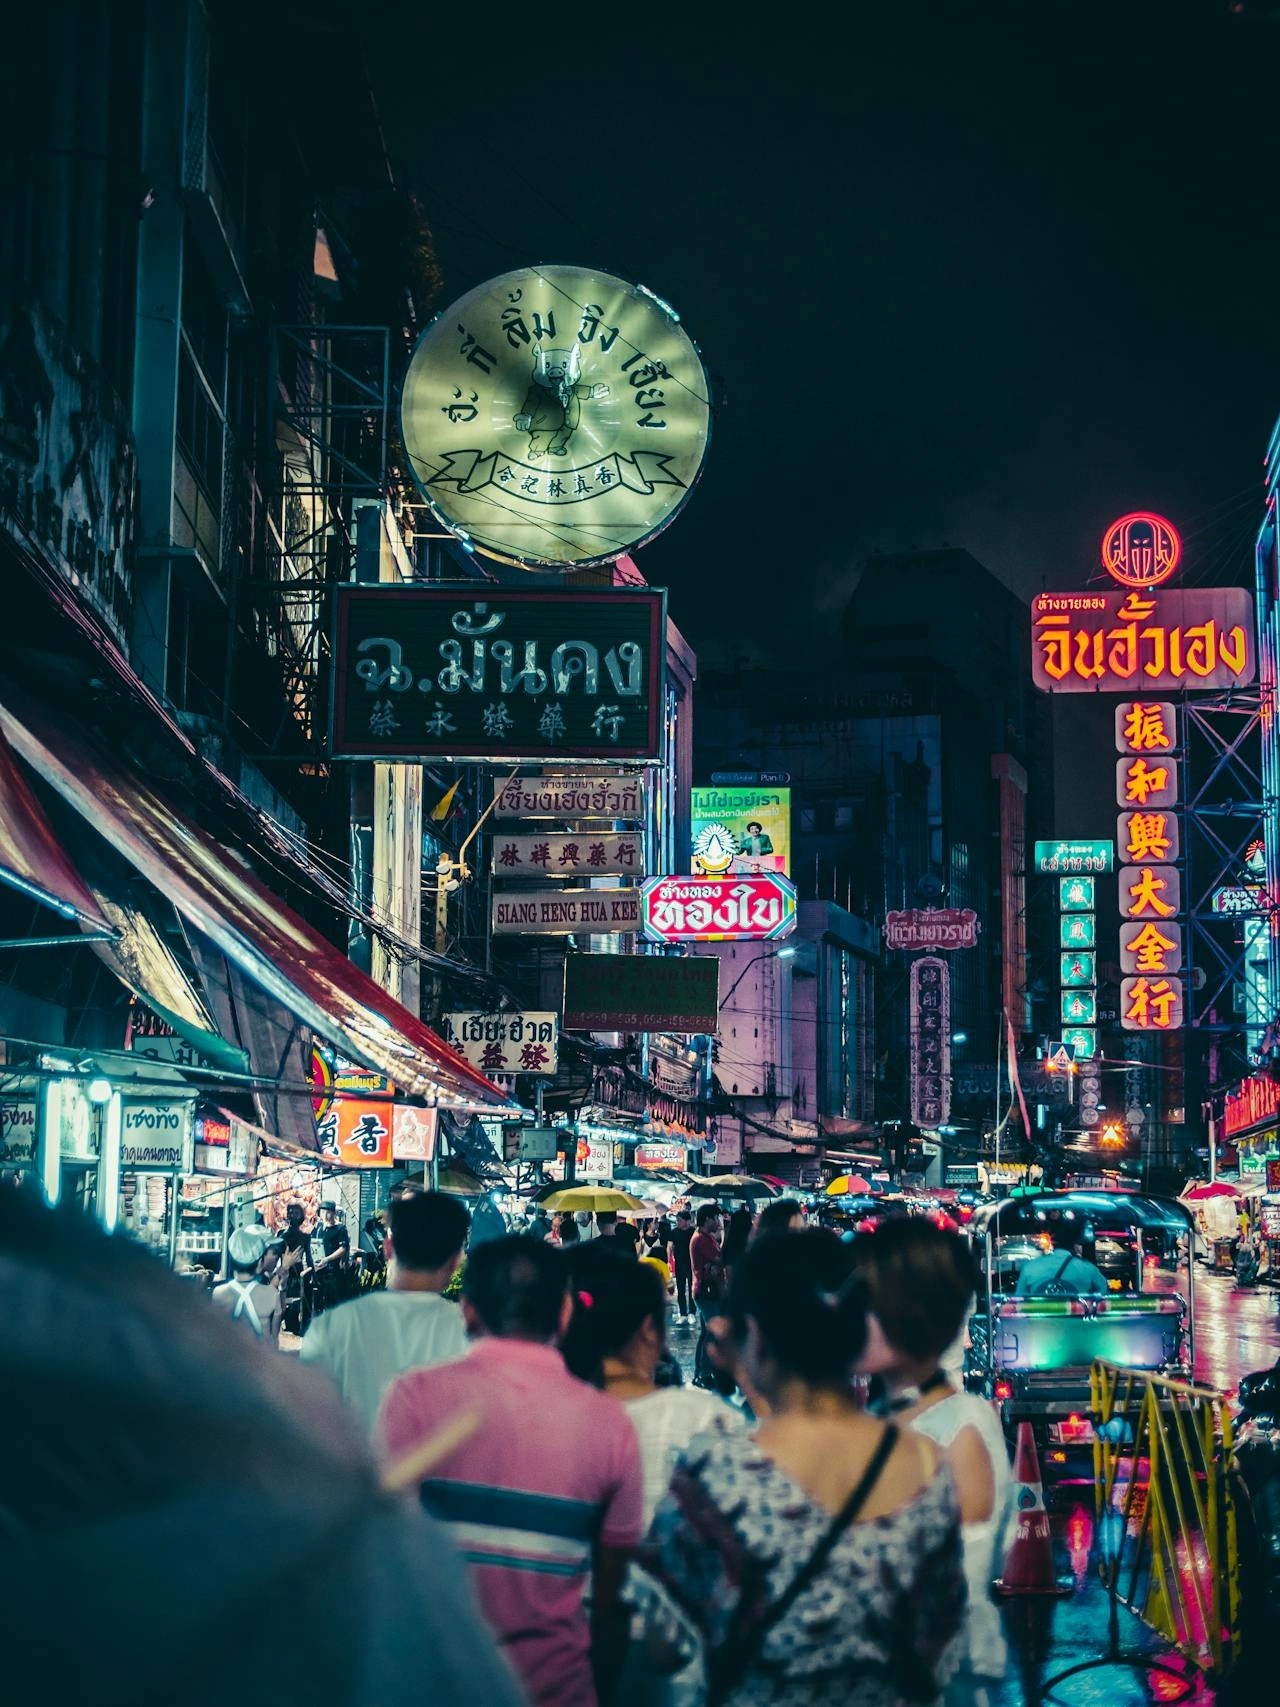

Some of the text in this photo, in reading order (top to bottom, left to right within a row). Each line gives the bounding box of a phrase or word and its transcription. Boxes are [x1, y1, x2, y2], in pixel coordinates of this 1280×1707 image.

[1035, 592, 1248, 681] จินฮั้วเฮง
[1124, 702, 1178, 1029] 振和興大金行
[497, 900, 638, 923] SIANG HENG HUA KEE
[651, 883, 781, 931] ทองใบ
[658, 881, 723, 899] ห้างทอง
